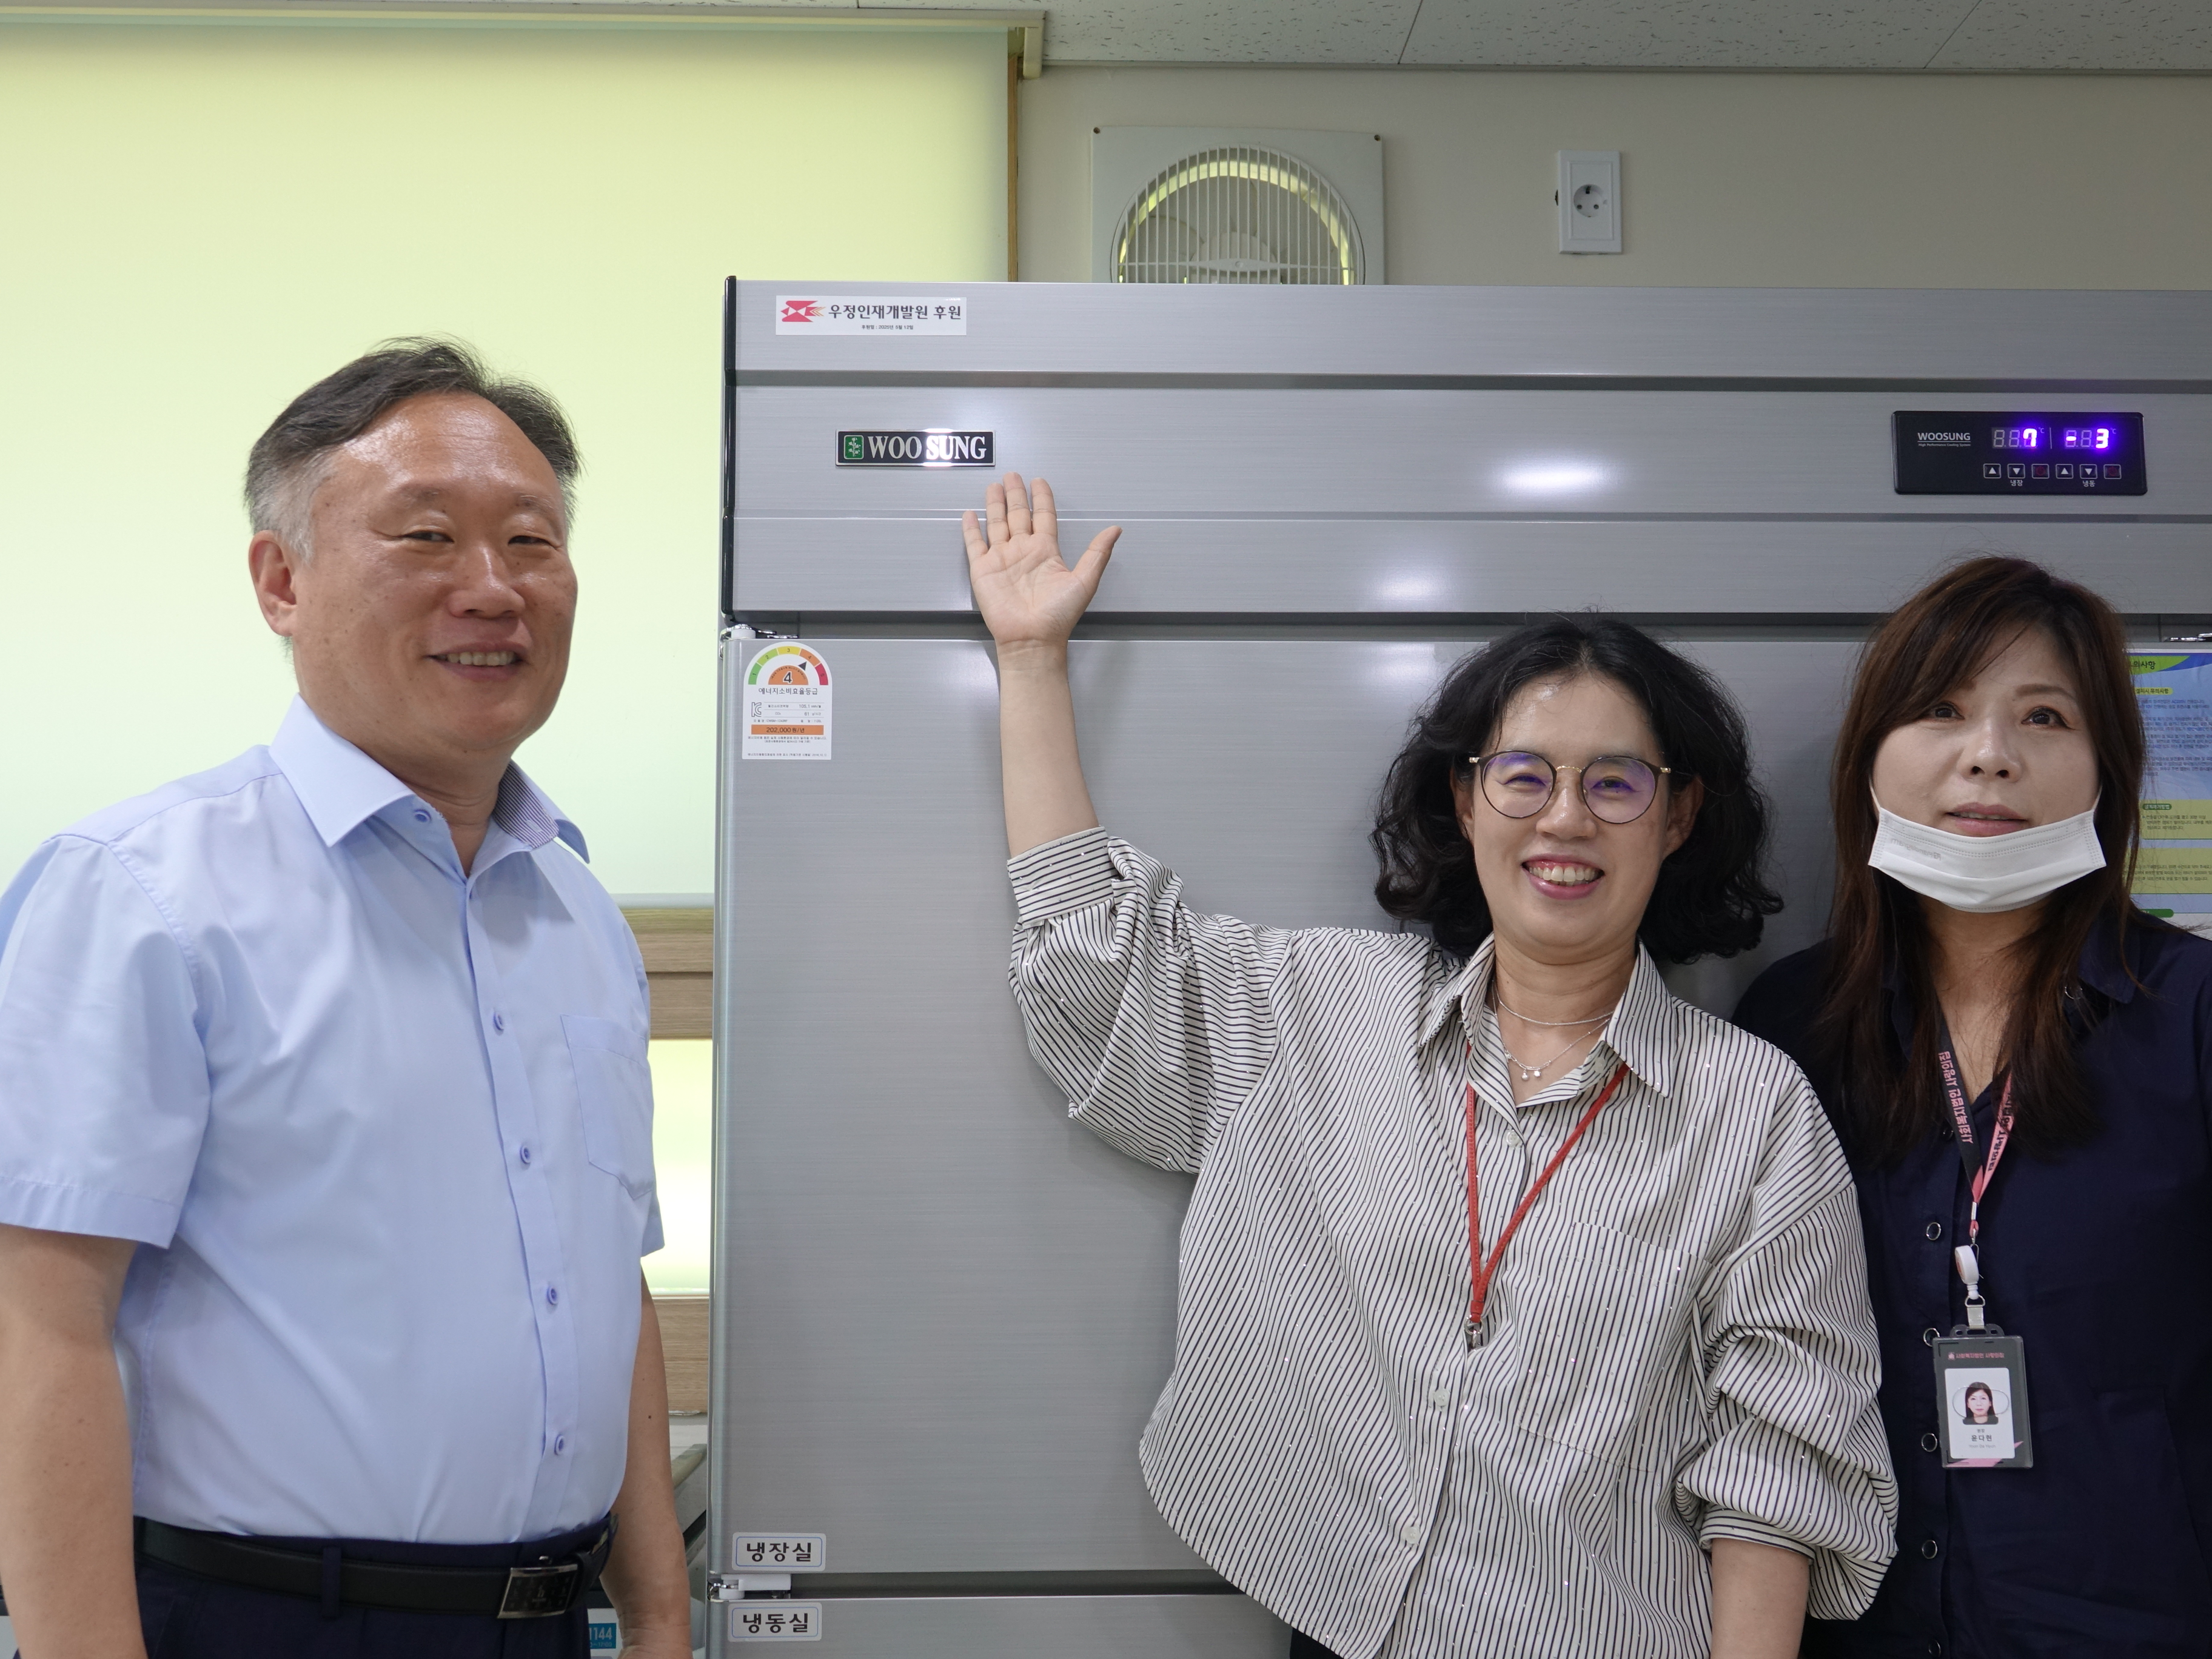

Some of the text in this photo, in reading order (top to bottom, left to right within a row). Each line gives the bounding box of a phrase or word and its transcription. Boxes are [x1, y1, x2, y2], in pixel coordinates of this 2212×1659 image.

[828, 304, 962, 320] 우정인재개발원 후원
[1917, 432, 1971, 441] WOOSUNG
[783, 671, 793, 683] 4
[1938, 1051, 1974, 1144] 사회복지법인 사랑의집
[746, 1542, 812, 1563] 냉장실
[743, 1613, 808, 1634] 냉동실
